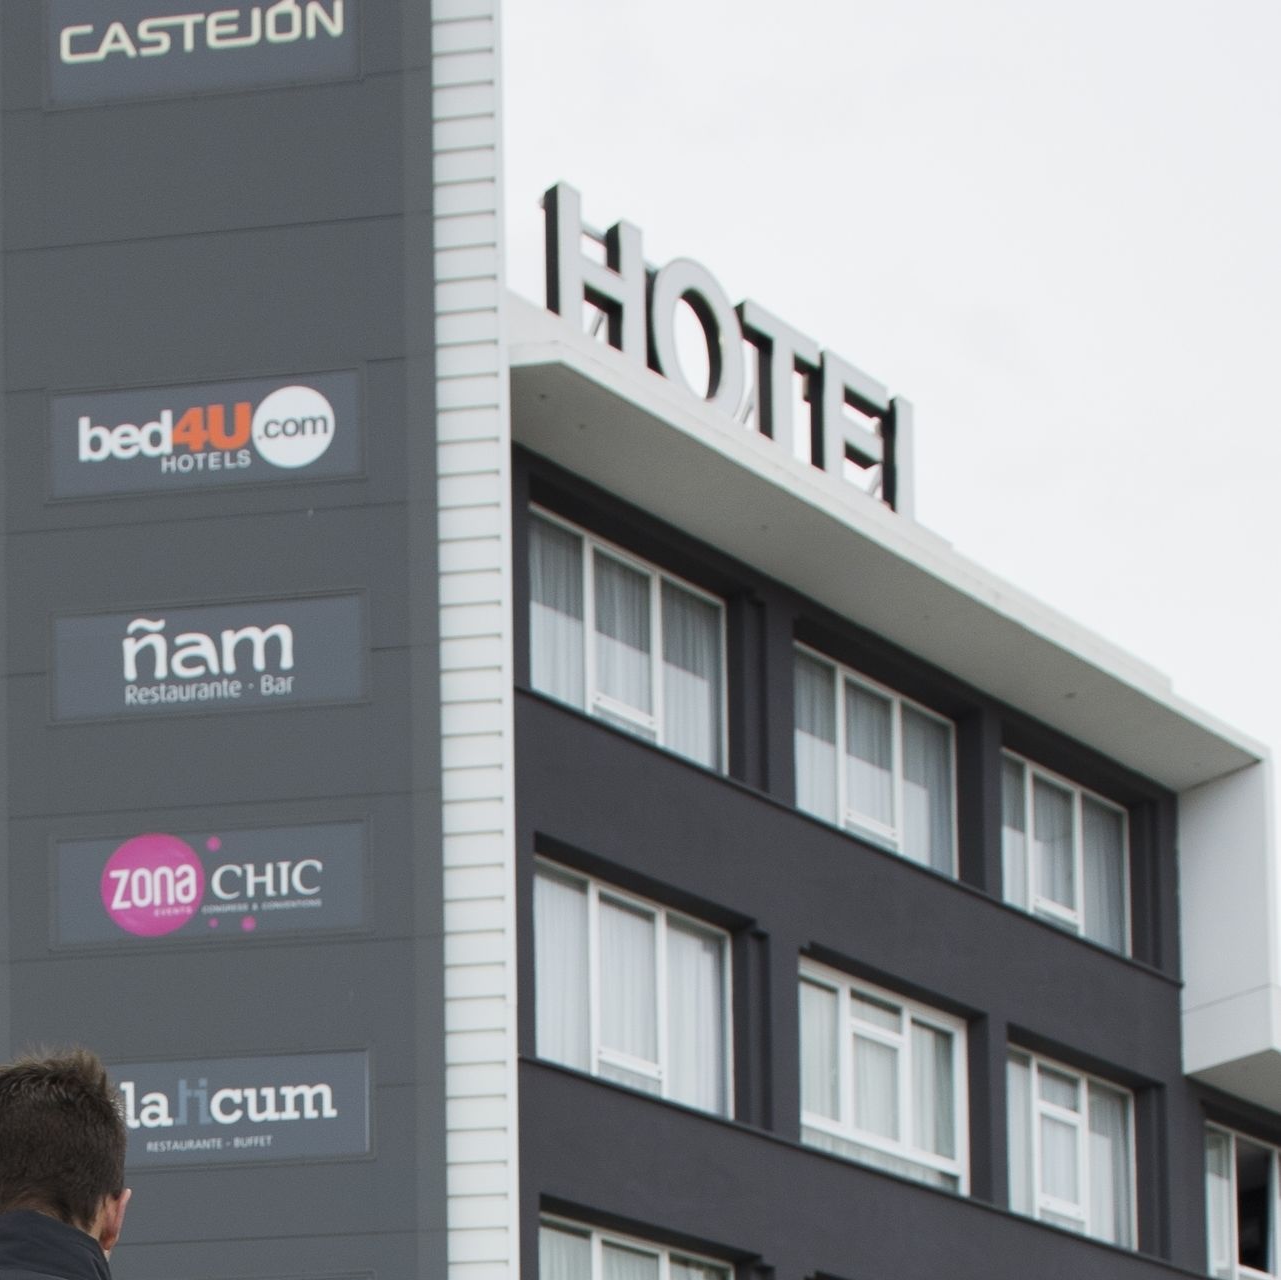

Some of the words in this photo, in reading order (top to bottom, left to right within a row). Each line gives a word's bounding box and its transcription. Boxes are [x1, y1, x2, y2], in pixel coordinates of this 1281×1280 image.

[60, 0, 344, 63] CASTEJÓN
[162, 449, 251, 473] HOTELS
[122, 618, 294, 682] ñam
[125, 679, 242, 705] Restaurante
[261, 674, 295, 695] Bar
[211, 859, 323, 900] CHIC
[120, 1078, 338, 1128] laticum
[146, 1137, 222, 1153] RESTAURANTE
[233, 1134, 273, 1148] BUFFET
